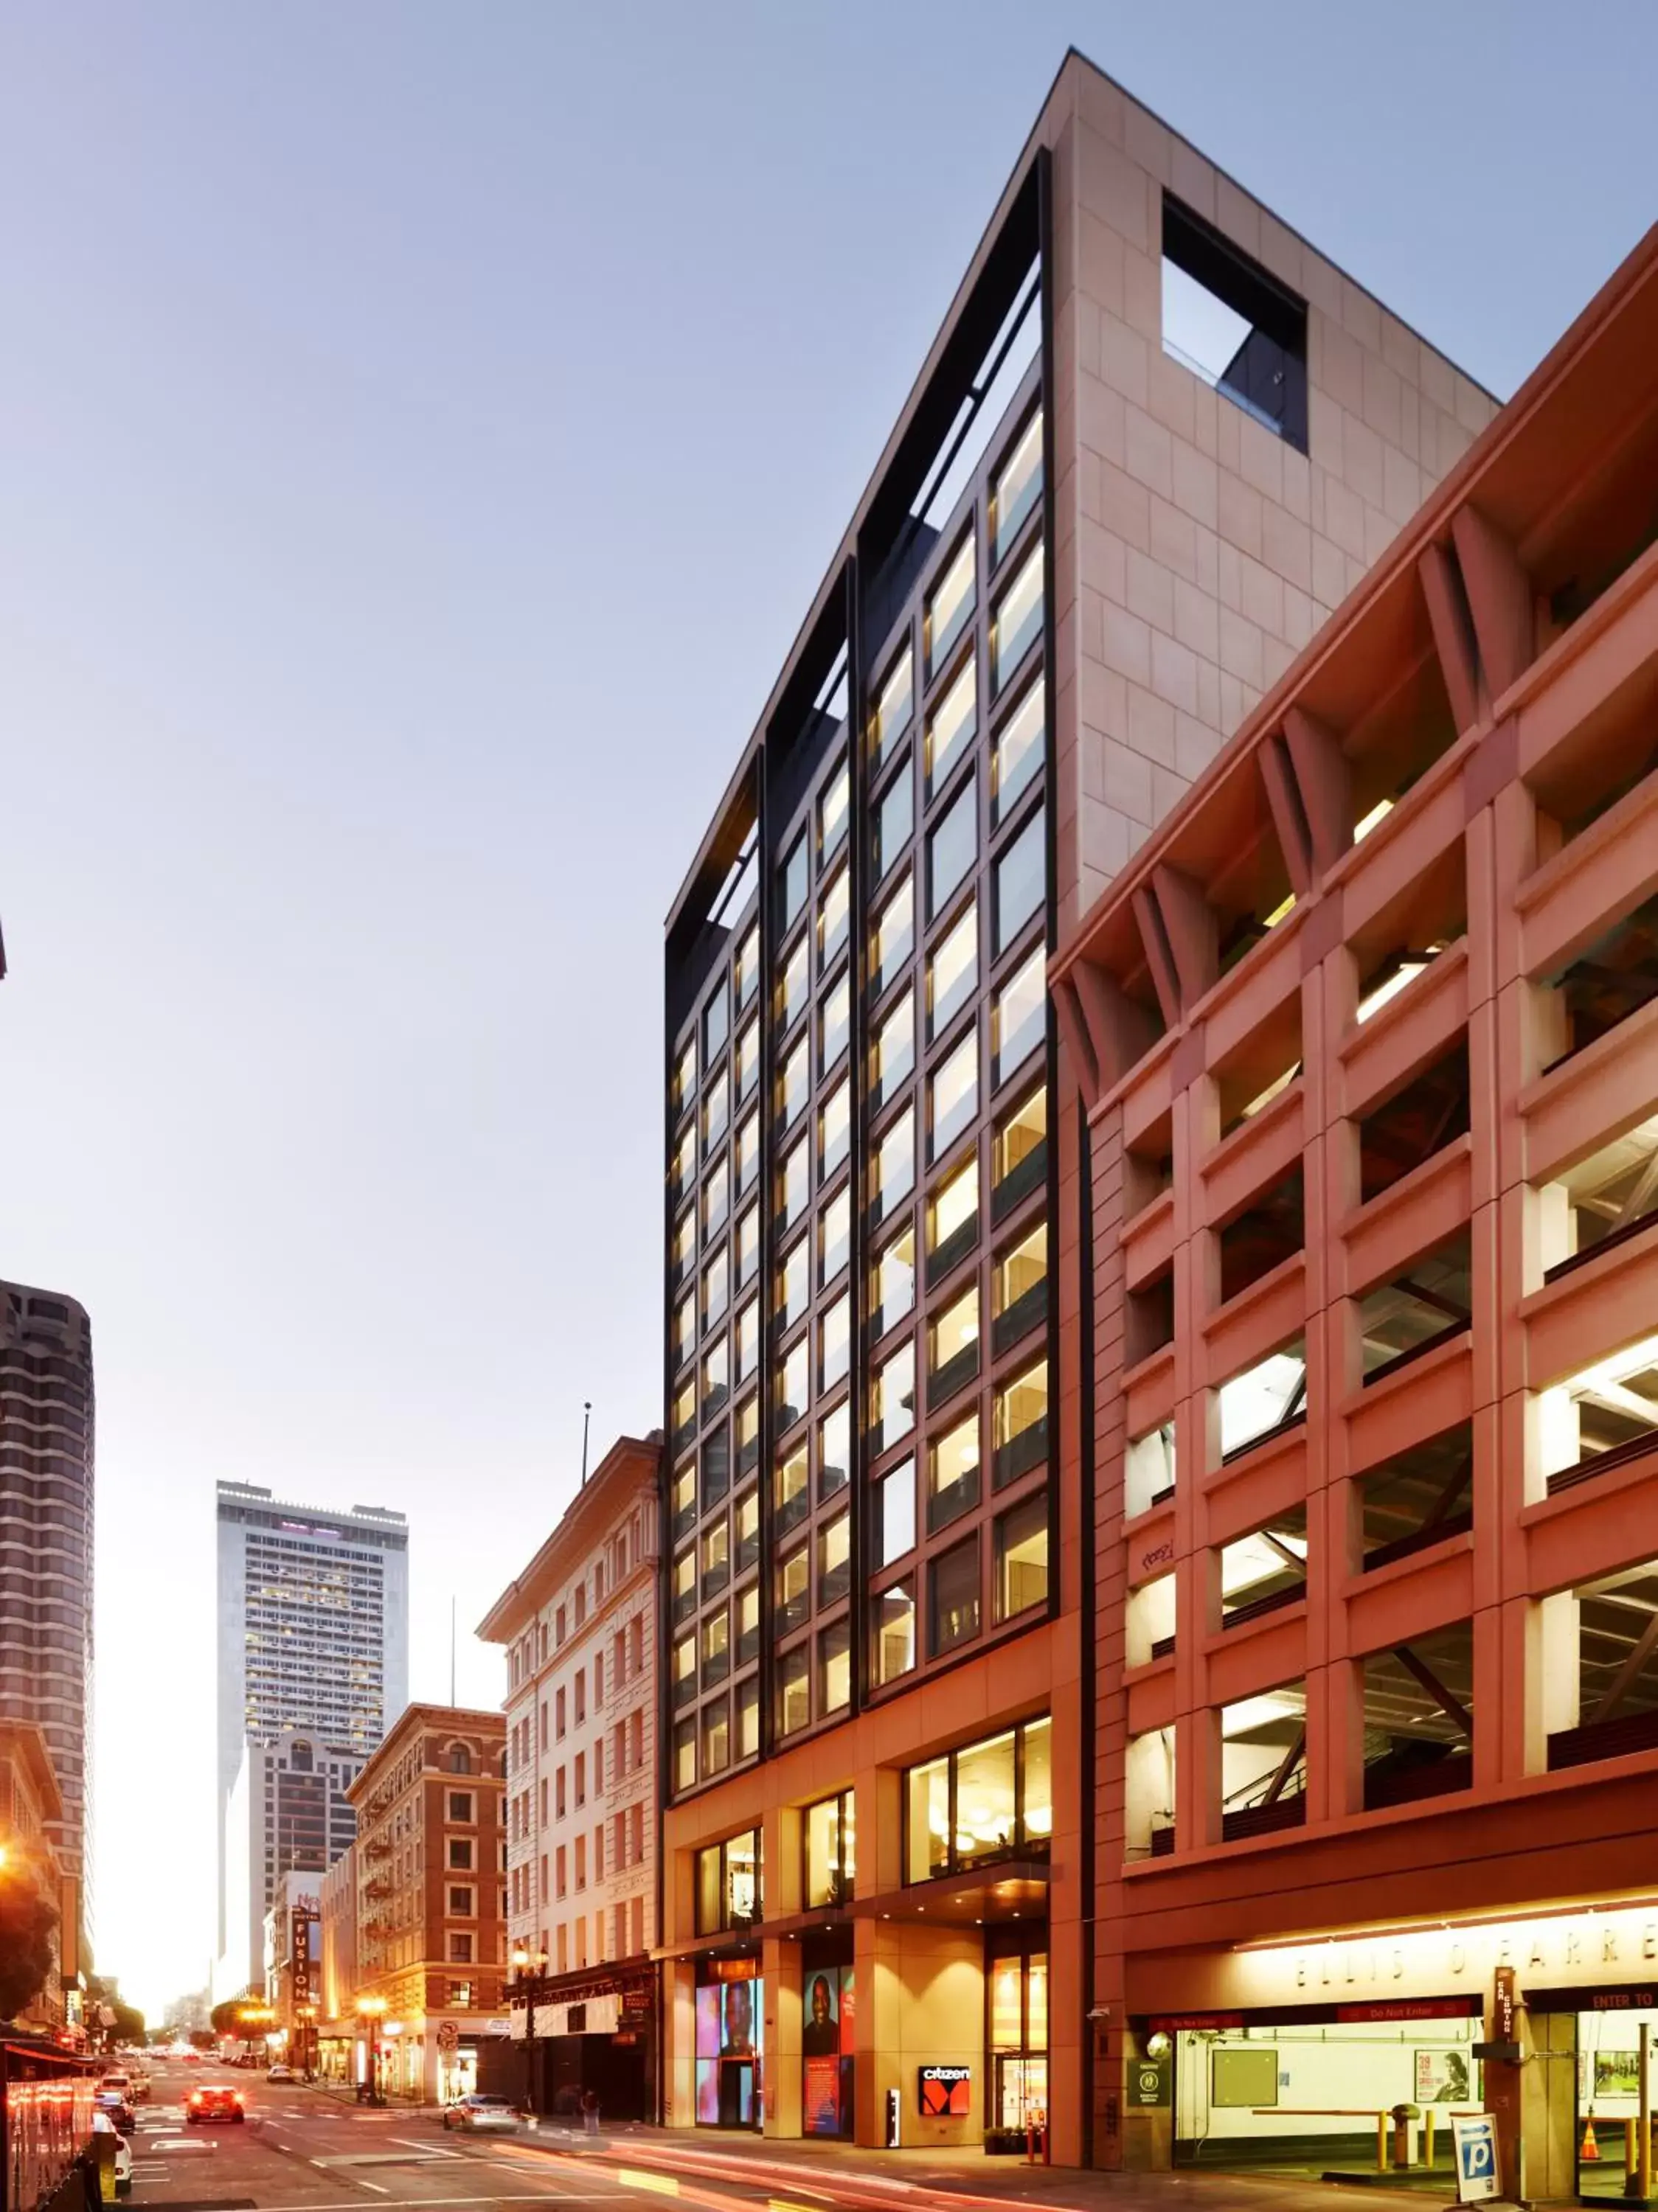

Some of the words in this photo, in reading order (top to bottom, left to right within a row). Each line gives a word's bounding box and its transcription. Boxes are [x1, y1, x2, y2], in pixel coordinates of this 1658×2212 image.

[296, 1924, 307, 1998] FUSION
[1297, 1950, 1403, 1987] ELLIS
[1593, 1994, 1630, 2009] ENTER
[1634, 1993, 1653, 2006] TO
[1370, 2008, 1384, 2019] Do
[1386, 2007, 1404, 2017] Not
[1406, 2006, 1432, 2016] Enter
[923, 2067, 970, 2080] citizen
